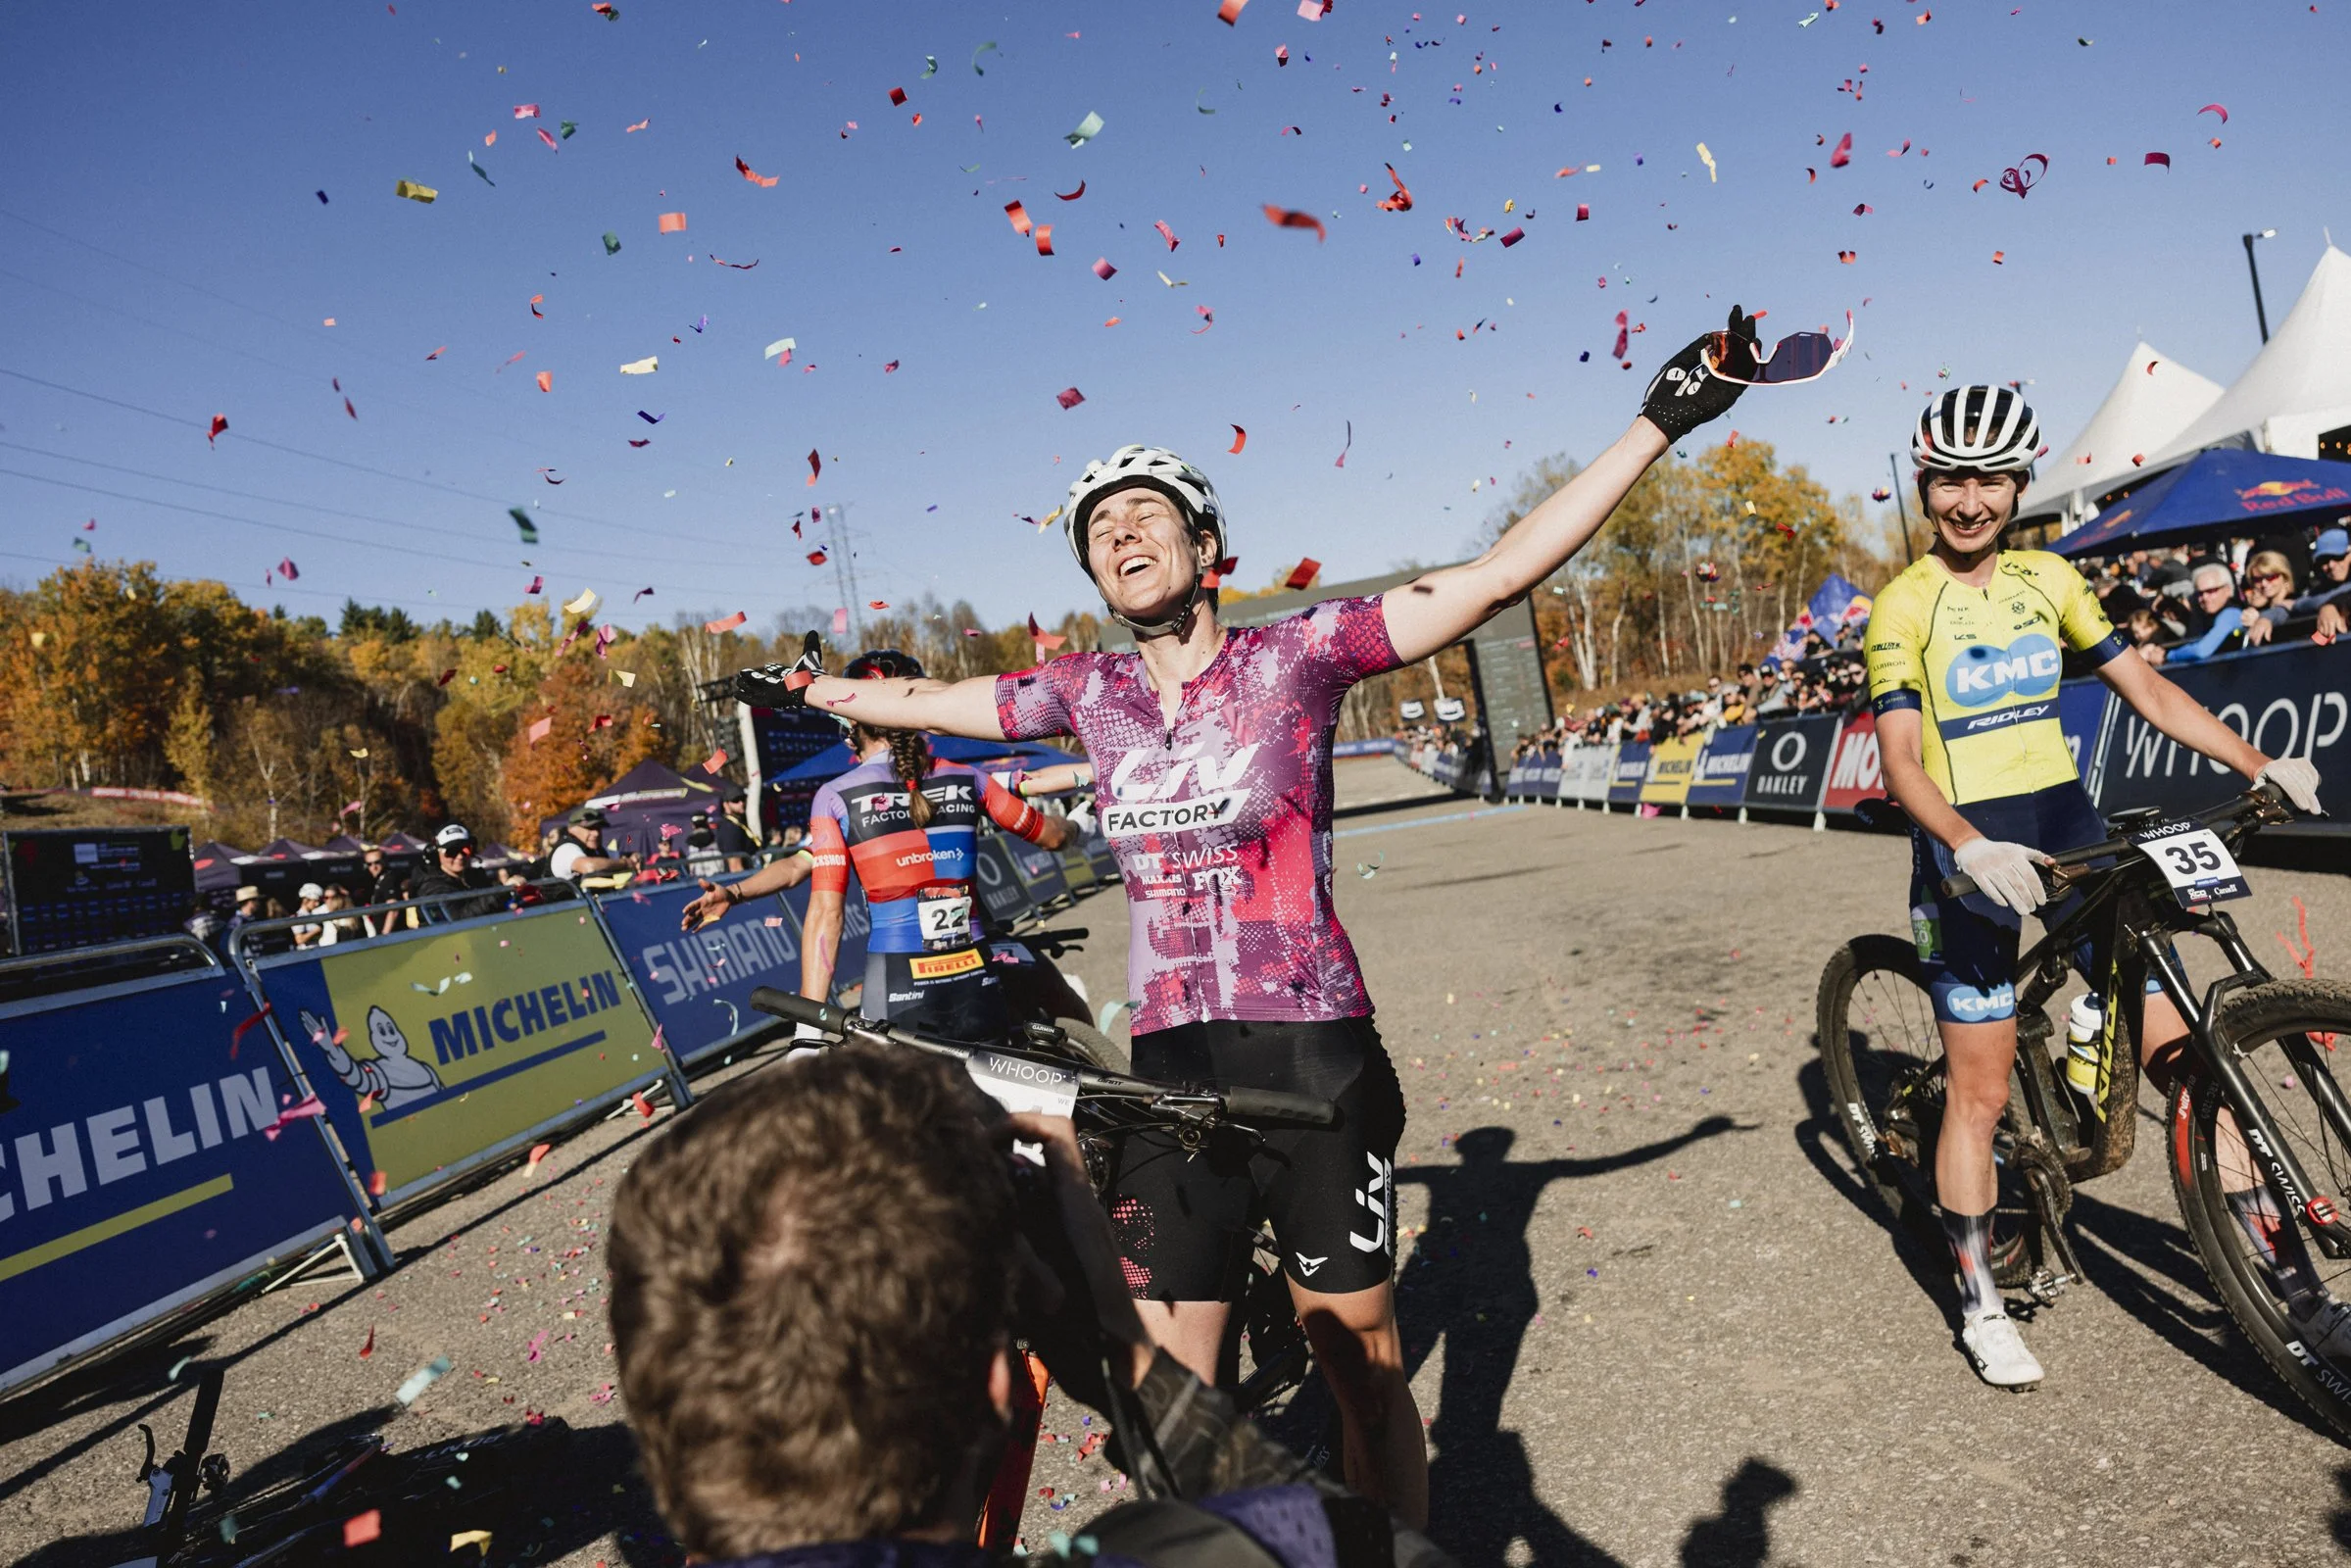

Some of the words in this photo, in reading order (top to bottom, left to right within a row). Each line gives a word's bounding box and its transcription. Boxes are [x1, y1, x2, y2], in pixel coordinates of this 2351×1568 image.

[2241, 494, 2295, 512] Red
[2297, 488, 2349, 503] Bull
[1957, 649, 2058, 694] KMC
[1967, 705, 2049, 730] RIDLEY
[1111, 741, 1260, 801] Liv
[1756, 775, 1808, 795] OAKLEY
[851, 785, 973, 813] TREK
[861, 808, 910, 828] FACTO
[936, 803, 976, 815] ACING
[1108, 802, 1227, 832] FACTORY
[2139, 821, 2191, 840] WHOOP
[896, 849, 956, 867] unbroken
[1132, 852, 1164, 871] DT
[1171, 843, 1240, 869] SWISS
[2165, 841, 2222, 874] 35
[1142, 873, 1183, 885] MAXXIS
[1192, 865, 1244, 895] FOX
[1145, 888, 1187, 899] SHIMANO
[931, 906, 966, 931] 22
[643, 914, 797, 1005] SHIMANO
[917, 954, 978, 974] PIRELLI
[888, 990, 925, 1003] Santini
[1951, 991, 2015, 1012] KMC
[427, 969, 622, 1066] MICHELIN
[1032, 1024, 1055, 1033] GARMIN
[989, 1056, 1063, 1085] WHOOP
[1098, 1077, 1125, 1086] GIANT
[1847, 1102, 1865, 1123] DT
[2247, 1129, 2274, 1157] DT
[1349, 1151, 1385, 1253] Liv
[2285, 1340, 2319, 1367] DT
[2315, 1369, 2351, 1405] SWI
